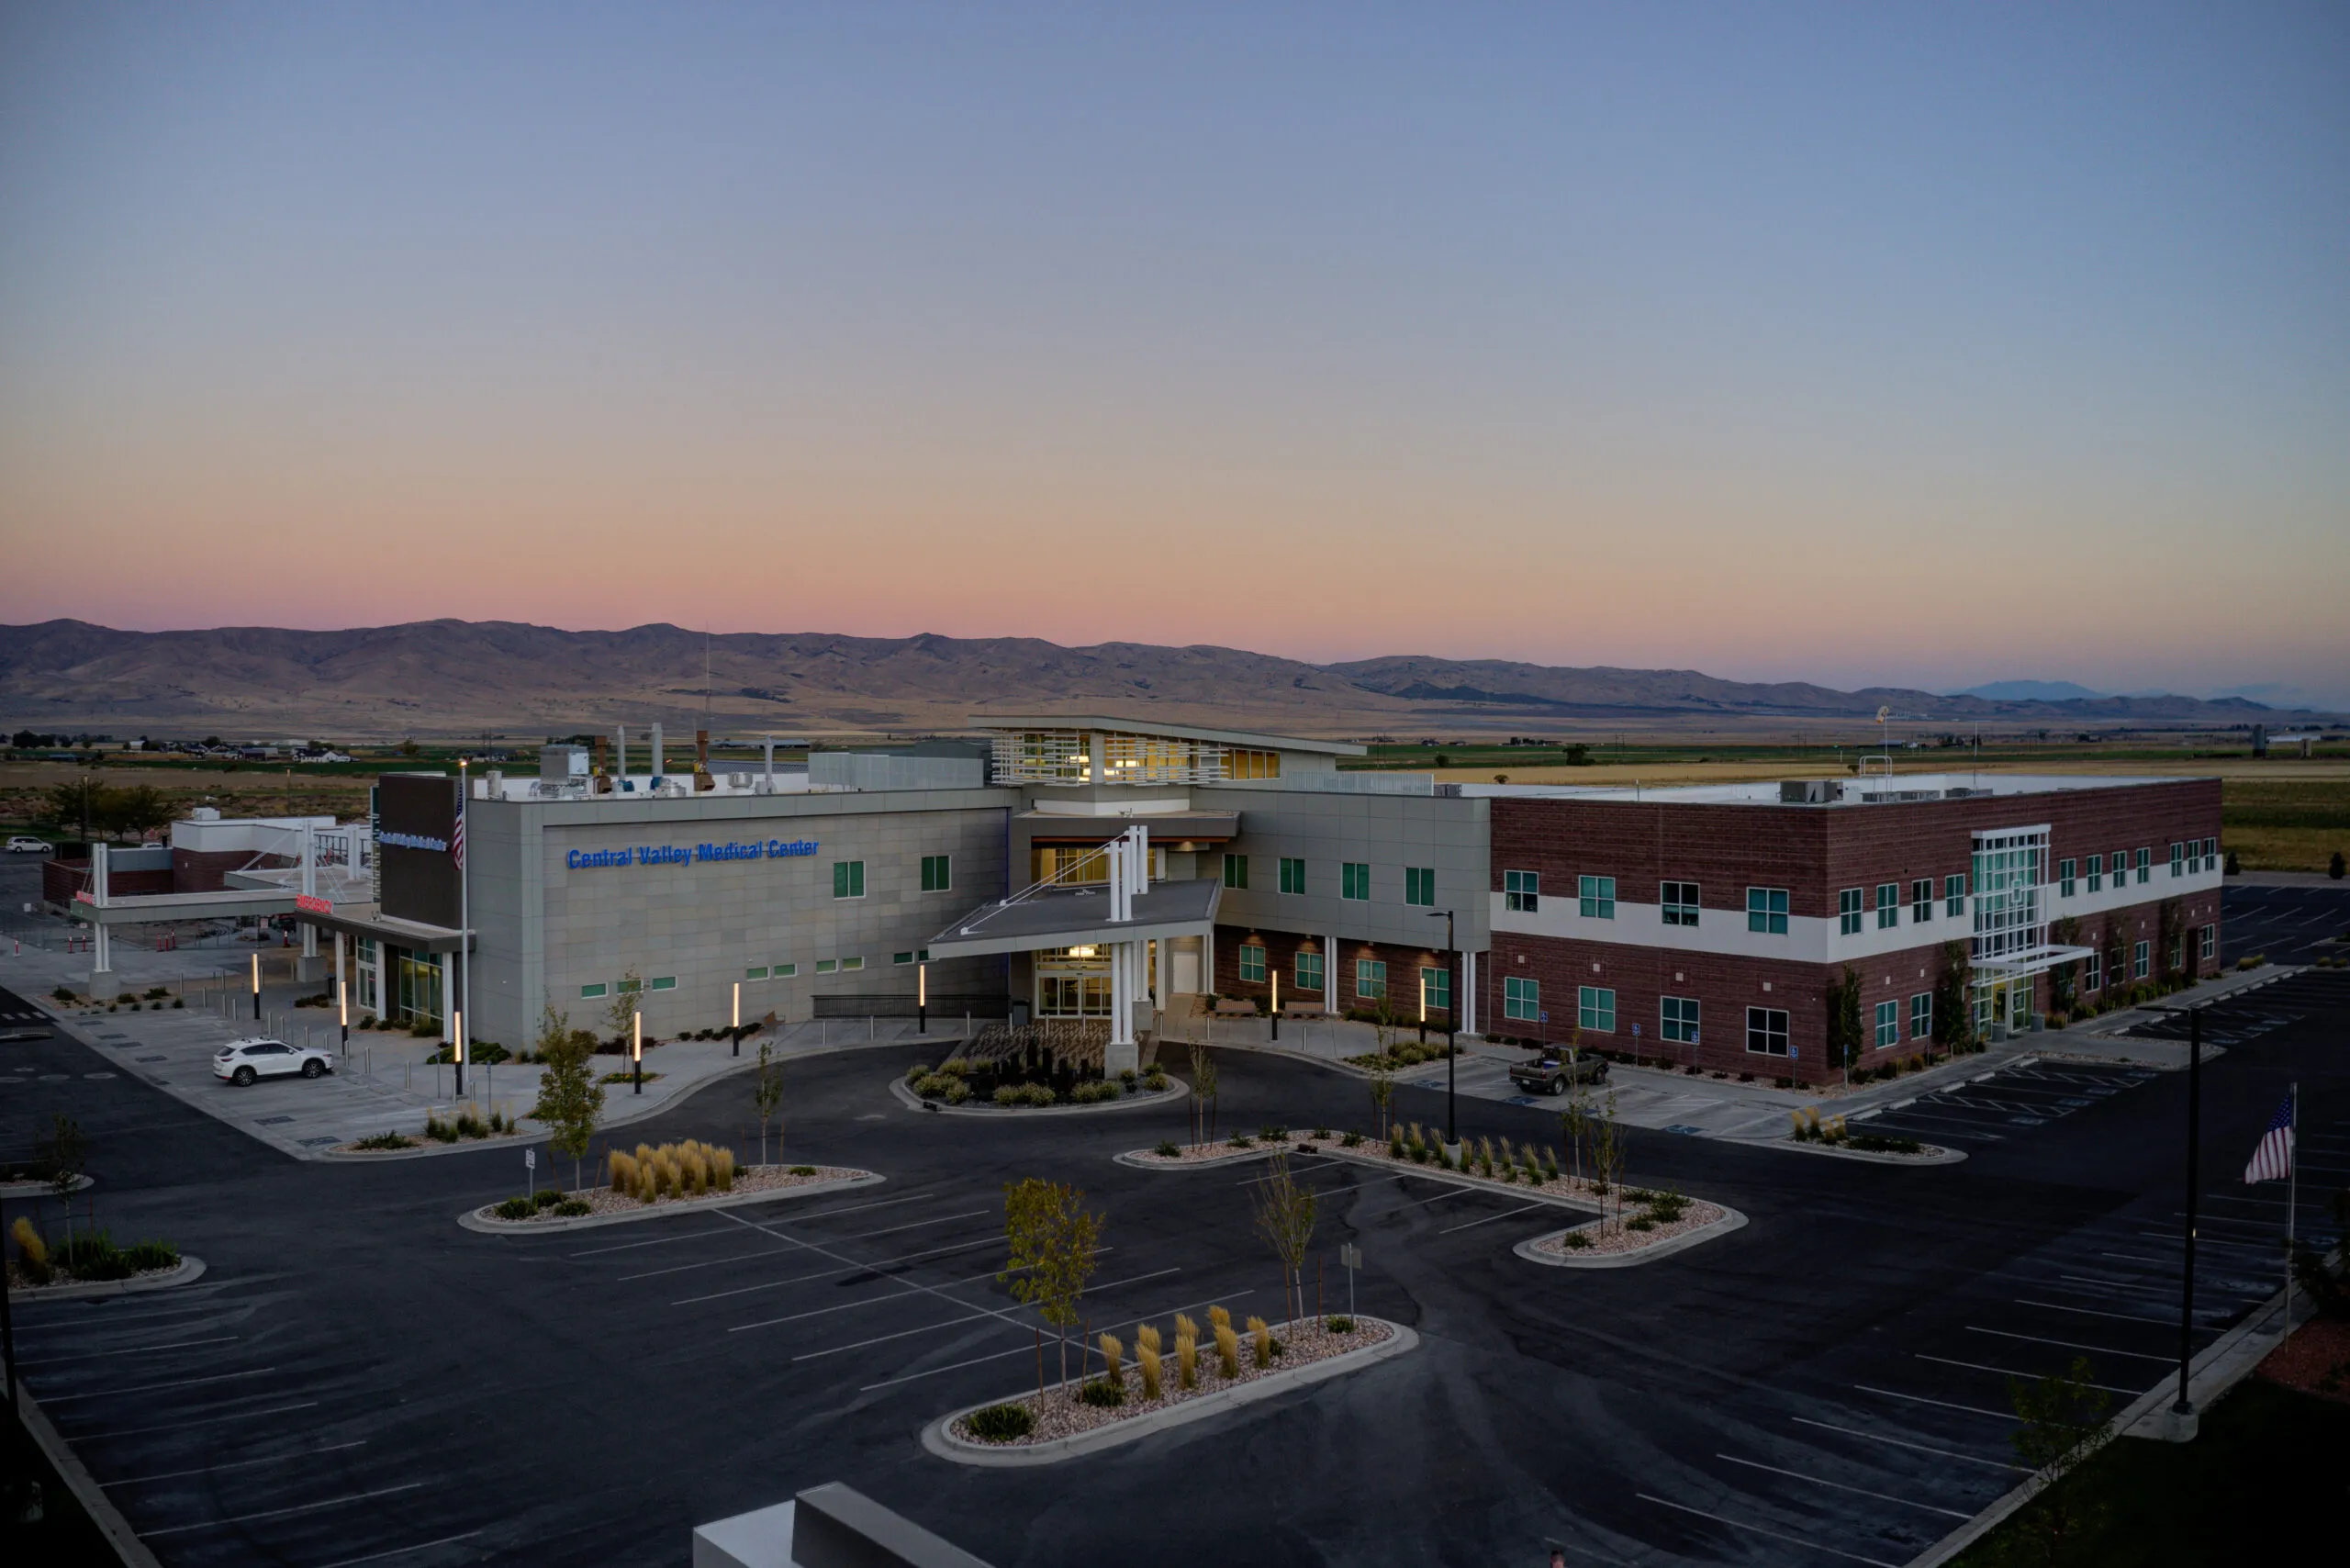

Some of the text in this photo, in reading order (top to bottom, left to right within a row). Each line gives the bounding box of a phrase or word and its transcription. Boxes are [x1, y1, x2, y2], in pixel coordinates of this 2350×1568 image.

[568, 839, 819, 868] Central Valley Medical Center
[297, 893, 333, 914] EMERGENCY
